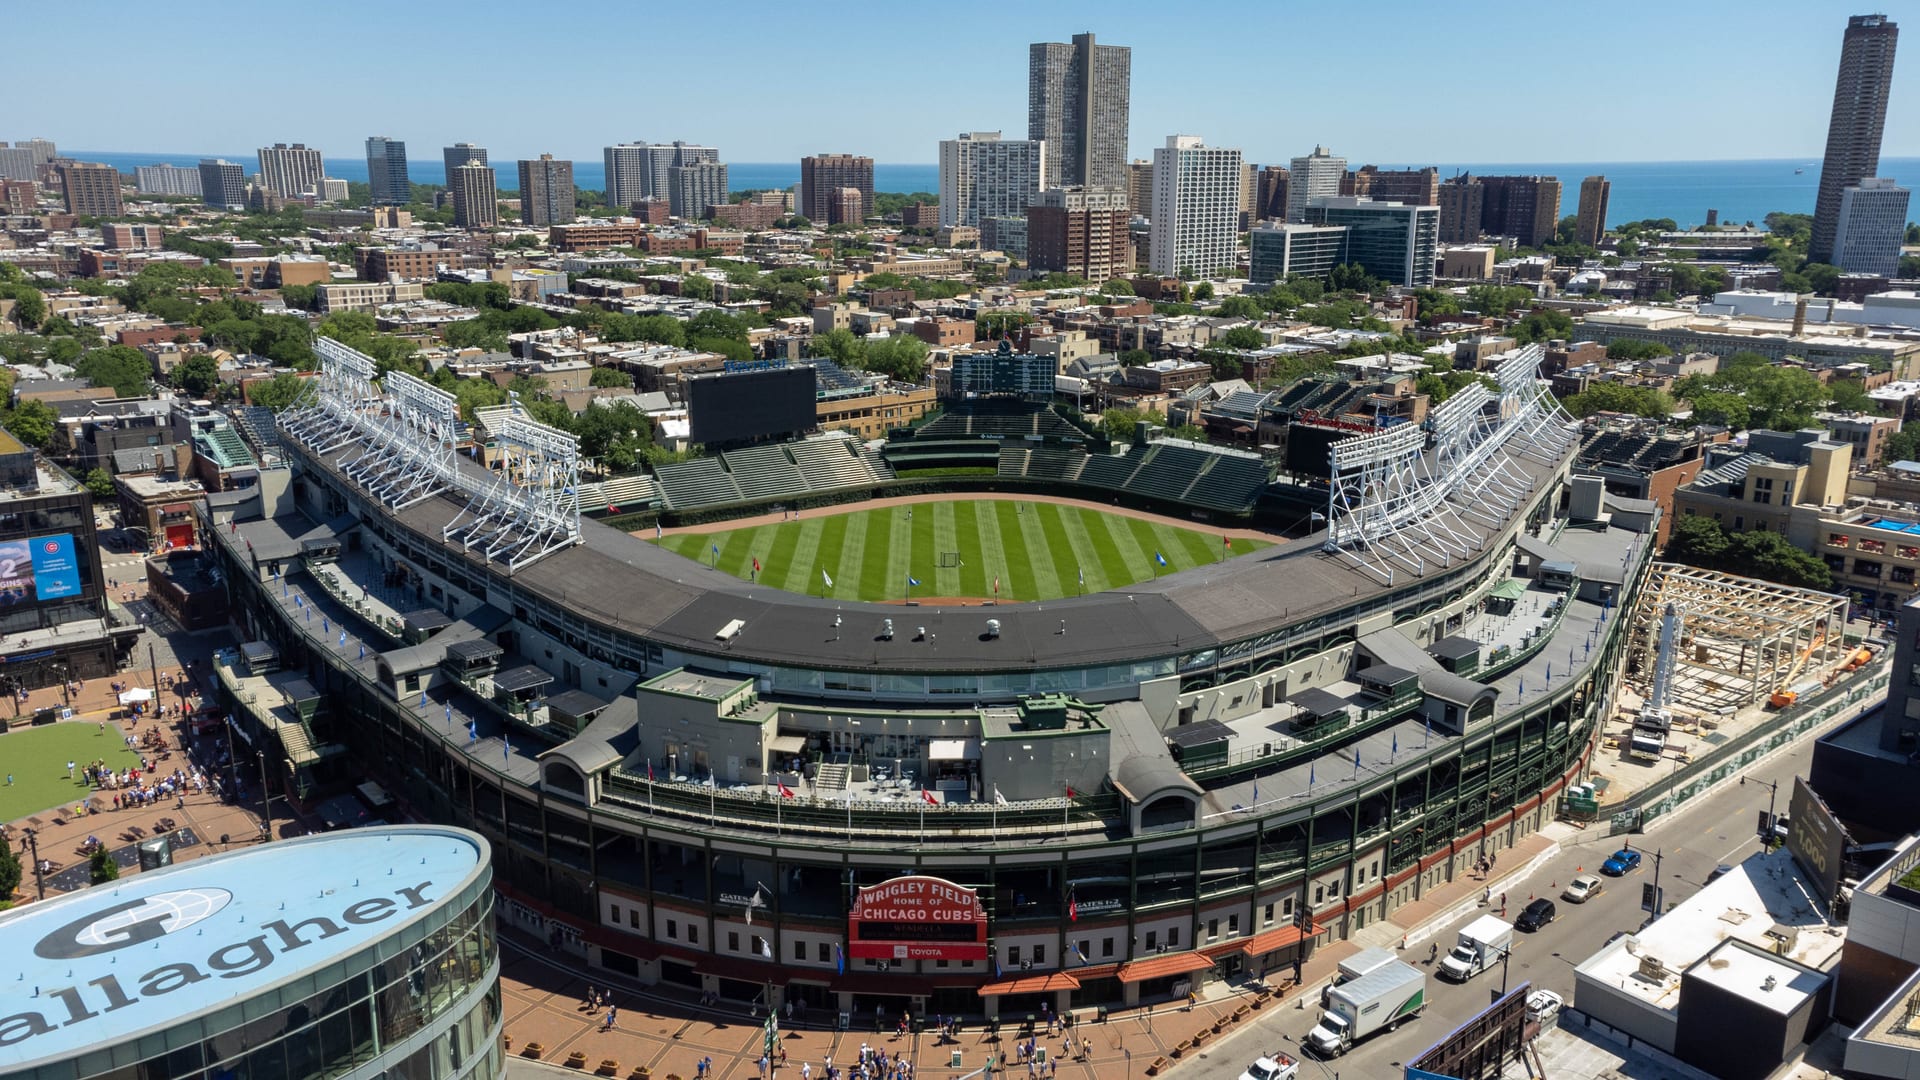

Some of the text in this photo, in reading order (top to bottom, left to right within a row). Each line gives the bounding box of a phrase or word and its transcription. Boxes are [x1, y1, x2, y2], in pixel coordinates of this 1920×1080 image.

[864, 882, 972, 905] WRIGLEY FIELD
[929, 898, 943, 906] OF
[863, 908, 972, 920] CHICAGO CUBS
[910, 948, 942, 956] TOYOTA
[0, 881, 434, 1047] allagher
